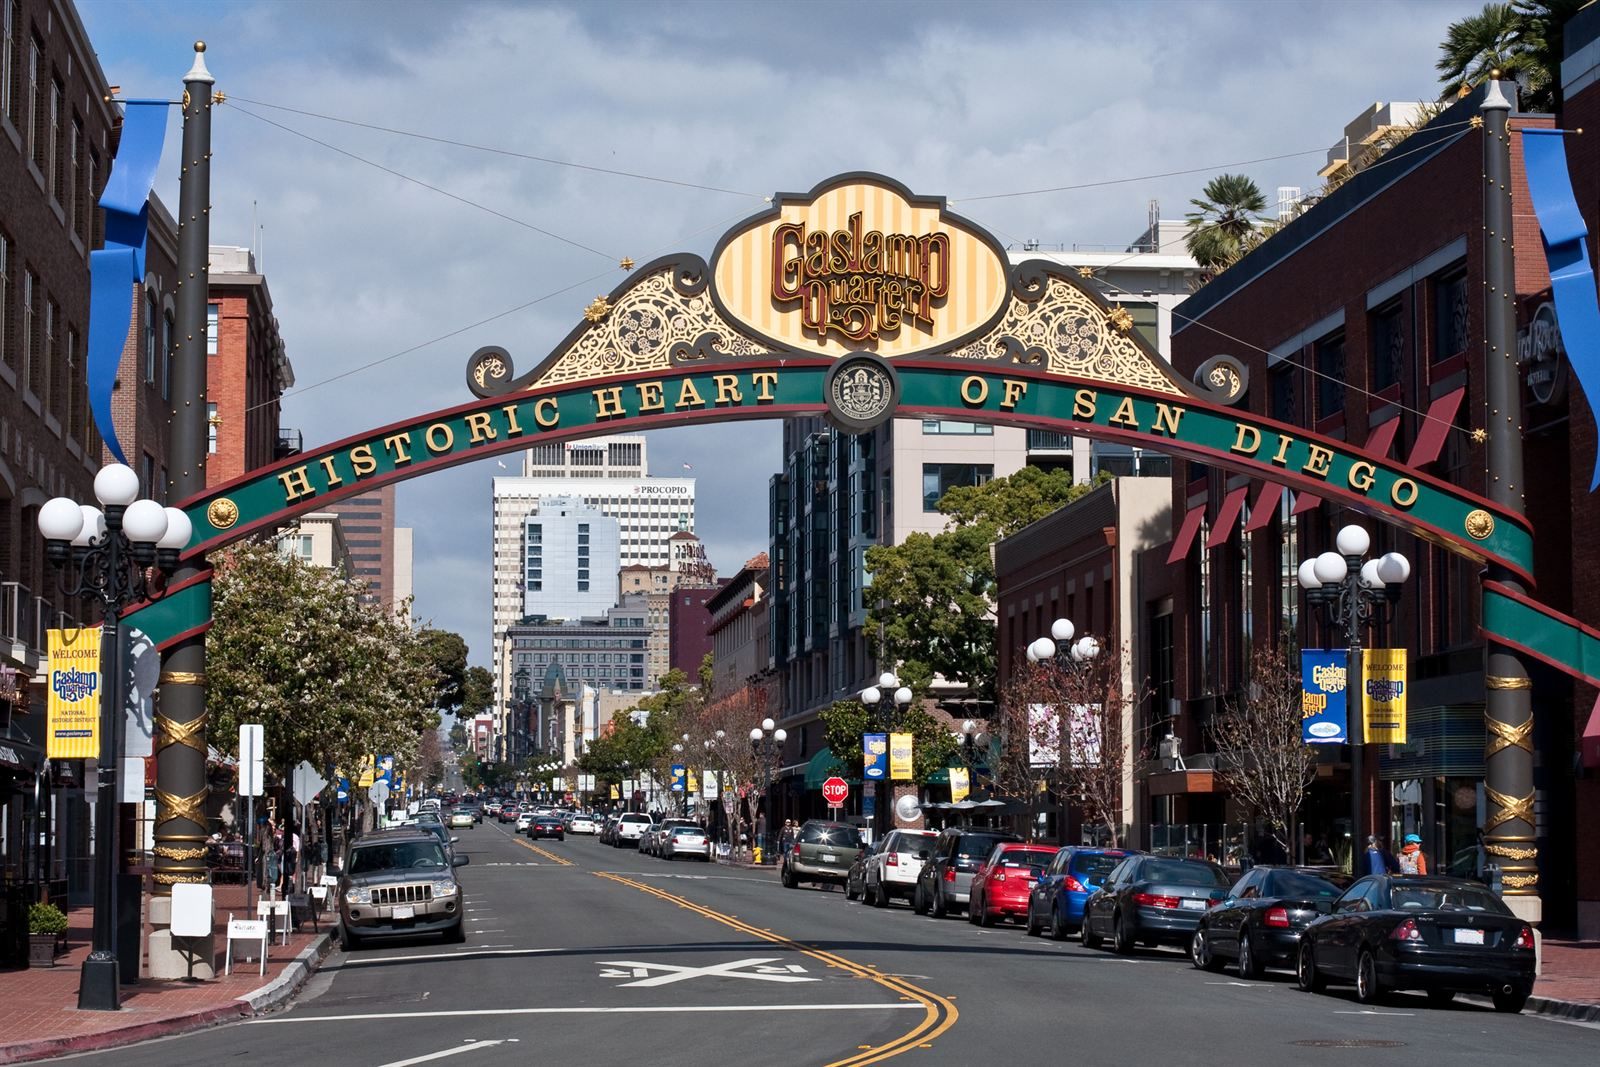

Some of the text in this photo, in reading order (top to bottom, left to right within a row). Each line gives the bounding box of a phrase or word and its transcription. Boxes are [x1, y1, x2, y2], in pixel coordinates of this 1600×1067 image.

[772, 211, 949, 325] Gaslamp
[801, 275, 924, 341] Quarter
[278, 372, 1418, 506] HISTORIC HEART OF SAN DIEGO
[641, 486, 687, 494] PROCOPIO
[53, 649, 97, 659] WELCOME
[53, 667, 97, 693] Gaslamp
[1366, 677, 1404, 695] Gaslamp
[60, 683, 92, 702] Quarter
[824, 785, 847, 796] STOP
